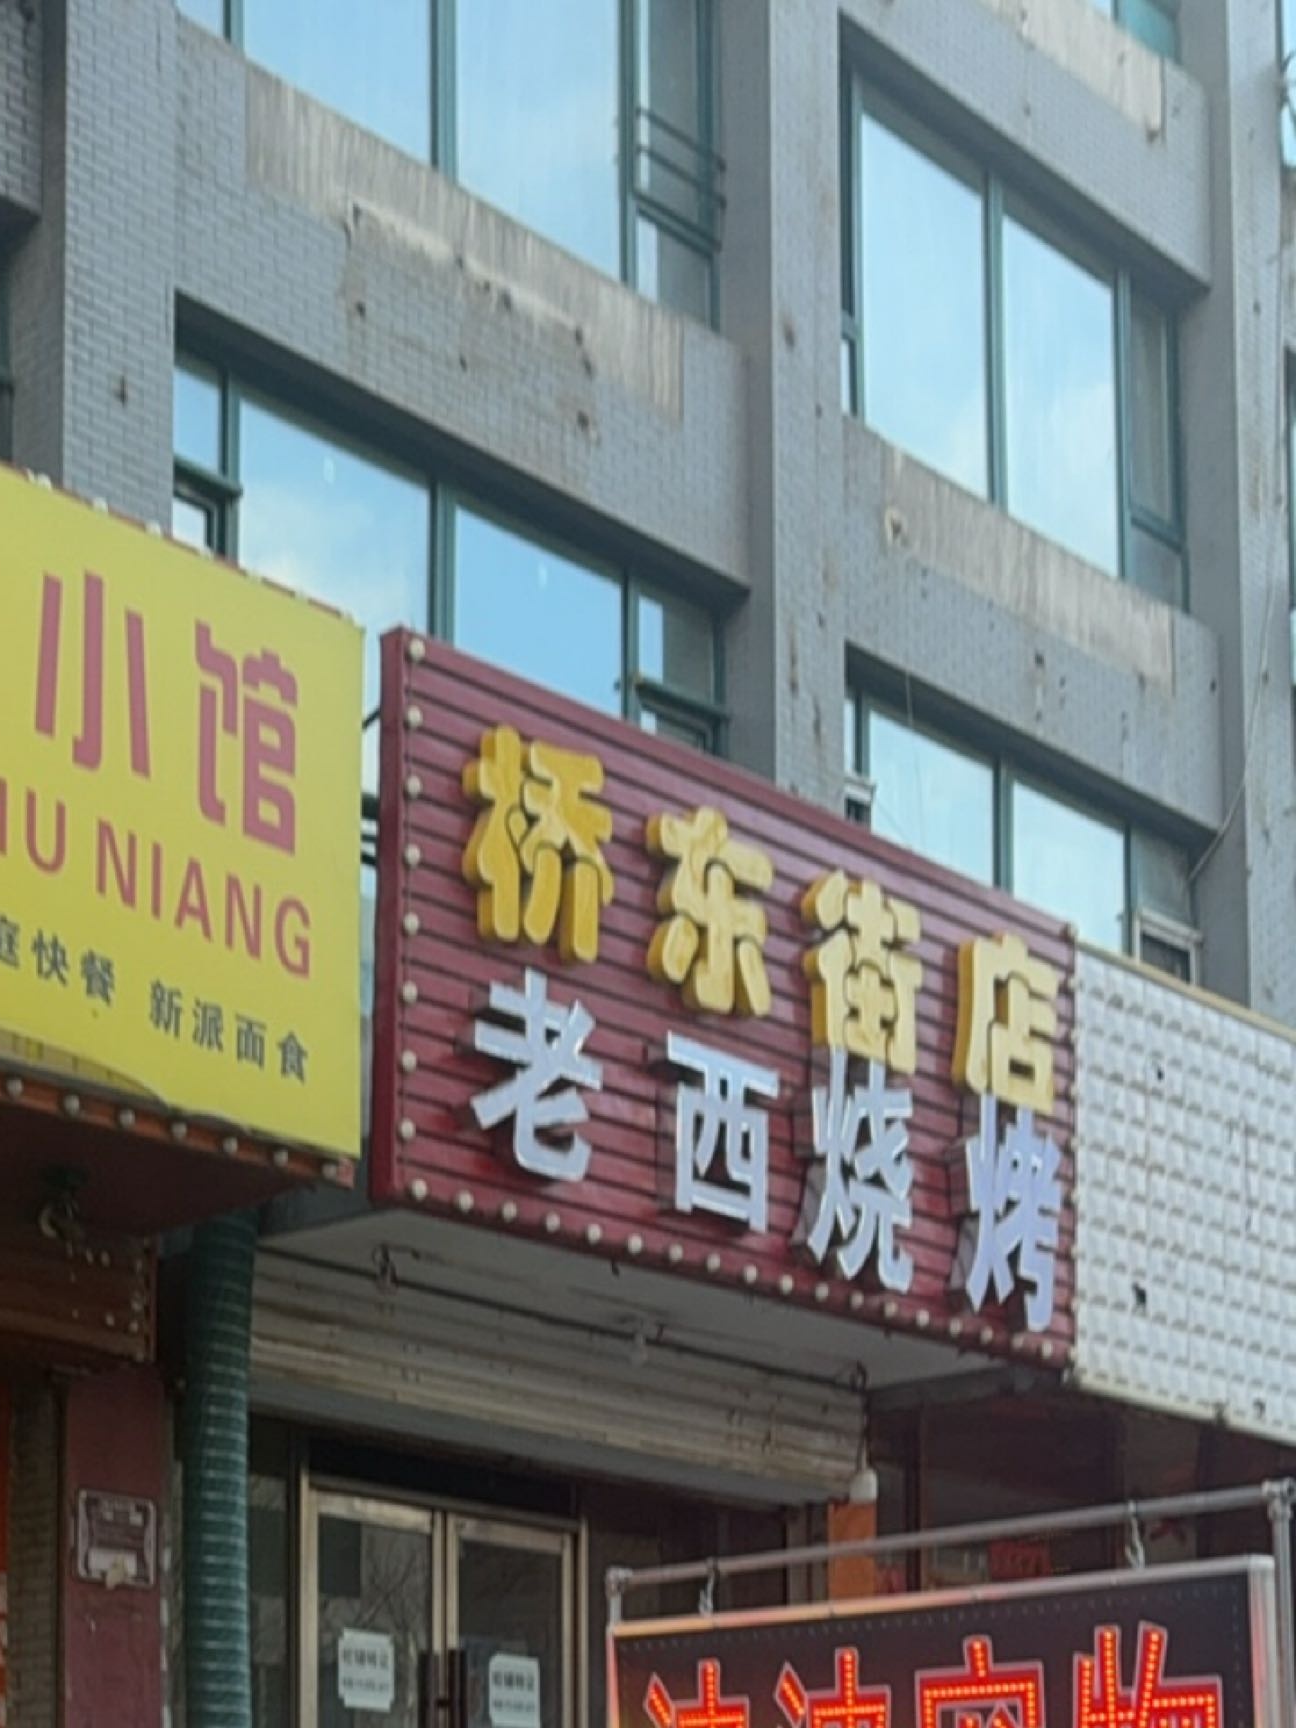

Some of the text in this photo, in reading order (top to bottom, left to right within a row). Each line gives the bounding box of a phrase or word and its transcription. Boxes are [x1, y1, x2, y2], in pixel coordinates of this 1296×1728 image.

[96, 818, 313, 979] NIANG
[462, 725, 1062, 1115] 桥东街店
[148, 977, 310, 1084] 新派面食
[470, 967, 1062, 1332] 老西烧烤
